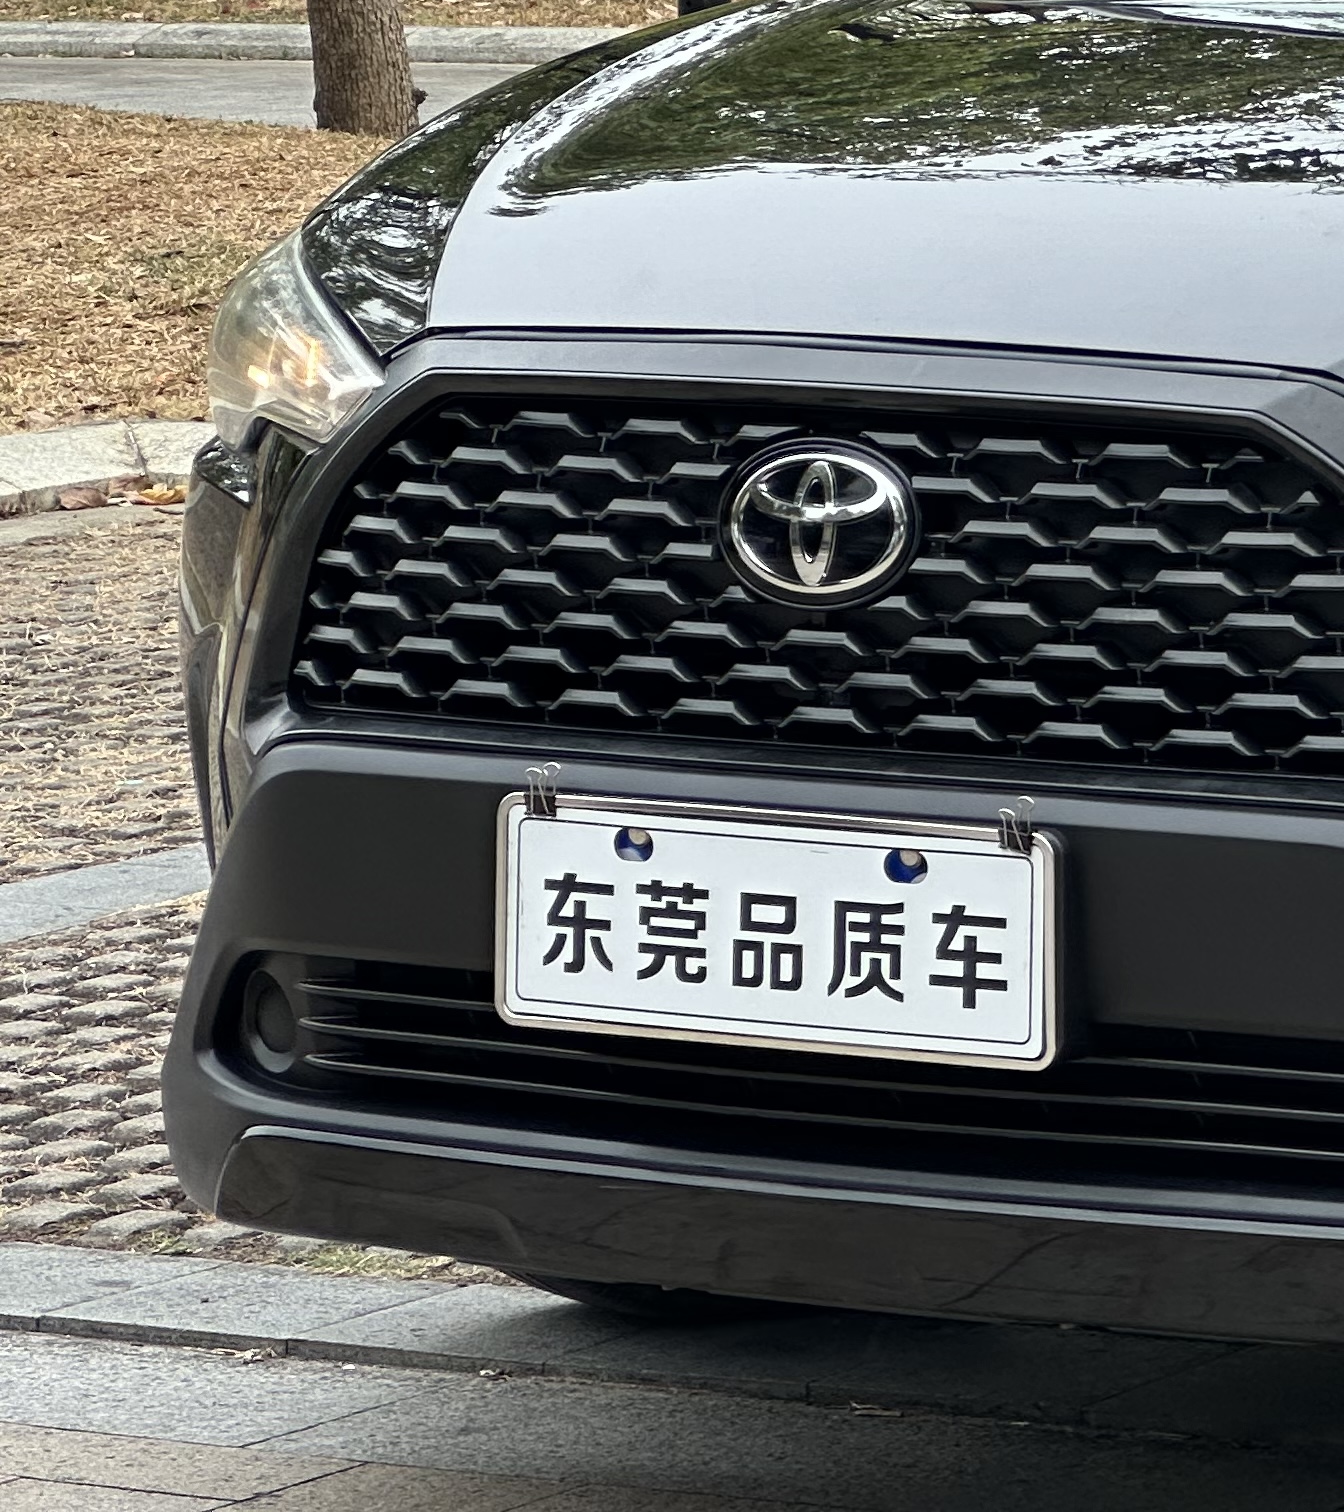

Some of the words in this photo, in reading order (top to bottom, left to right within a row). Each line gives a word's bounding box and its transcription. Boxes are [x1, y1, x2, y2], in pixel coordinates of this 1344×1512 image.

[542, 872, 1008, 1009] 东莞品质车
